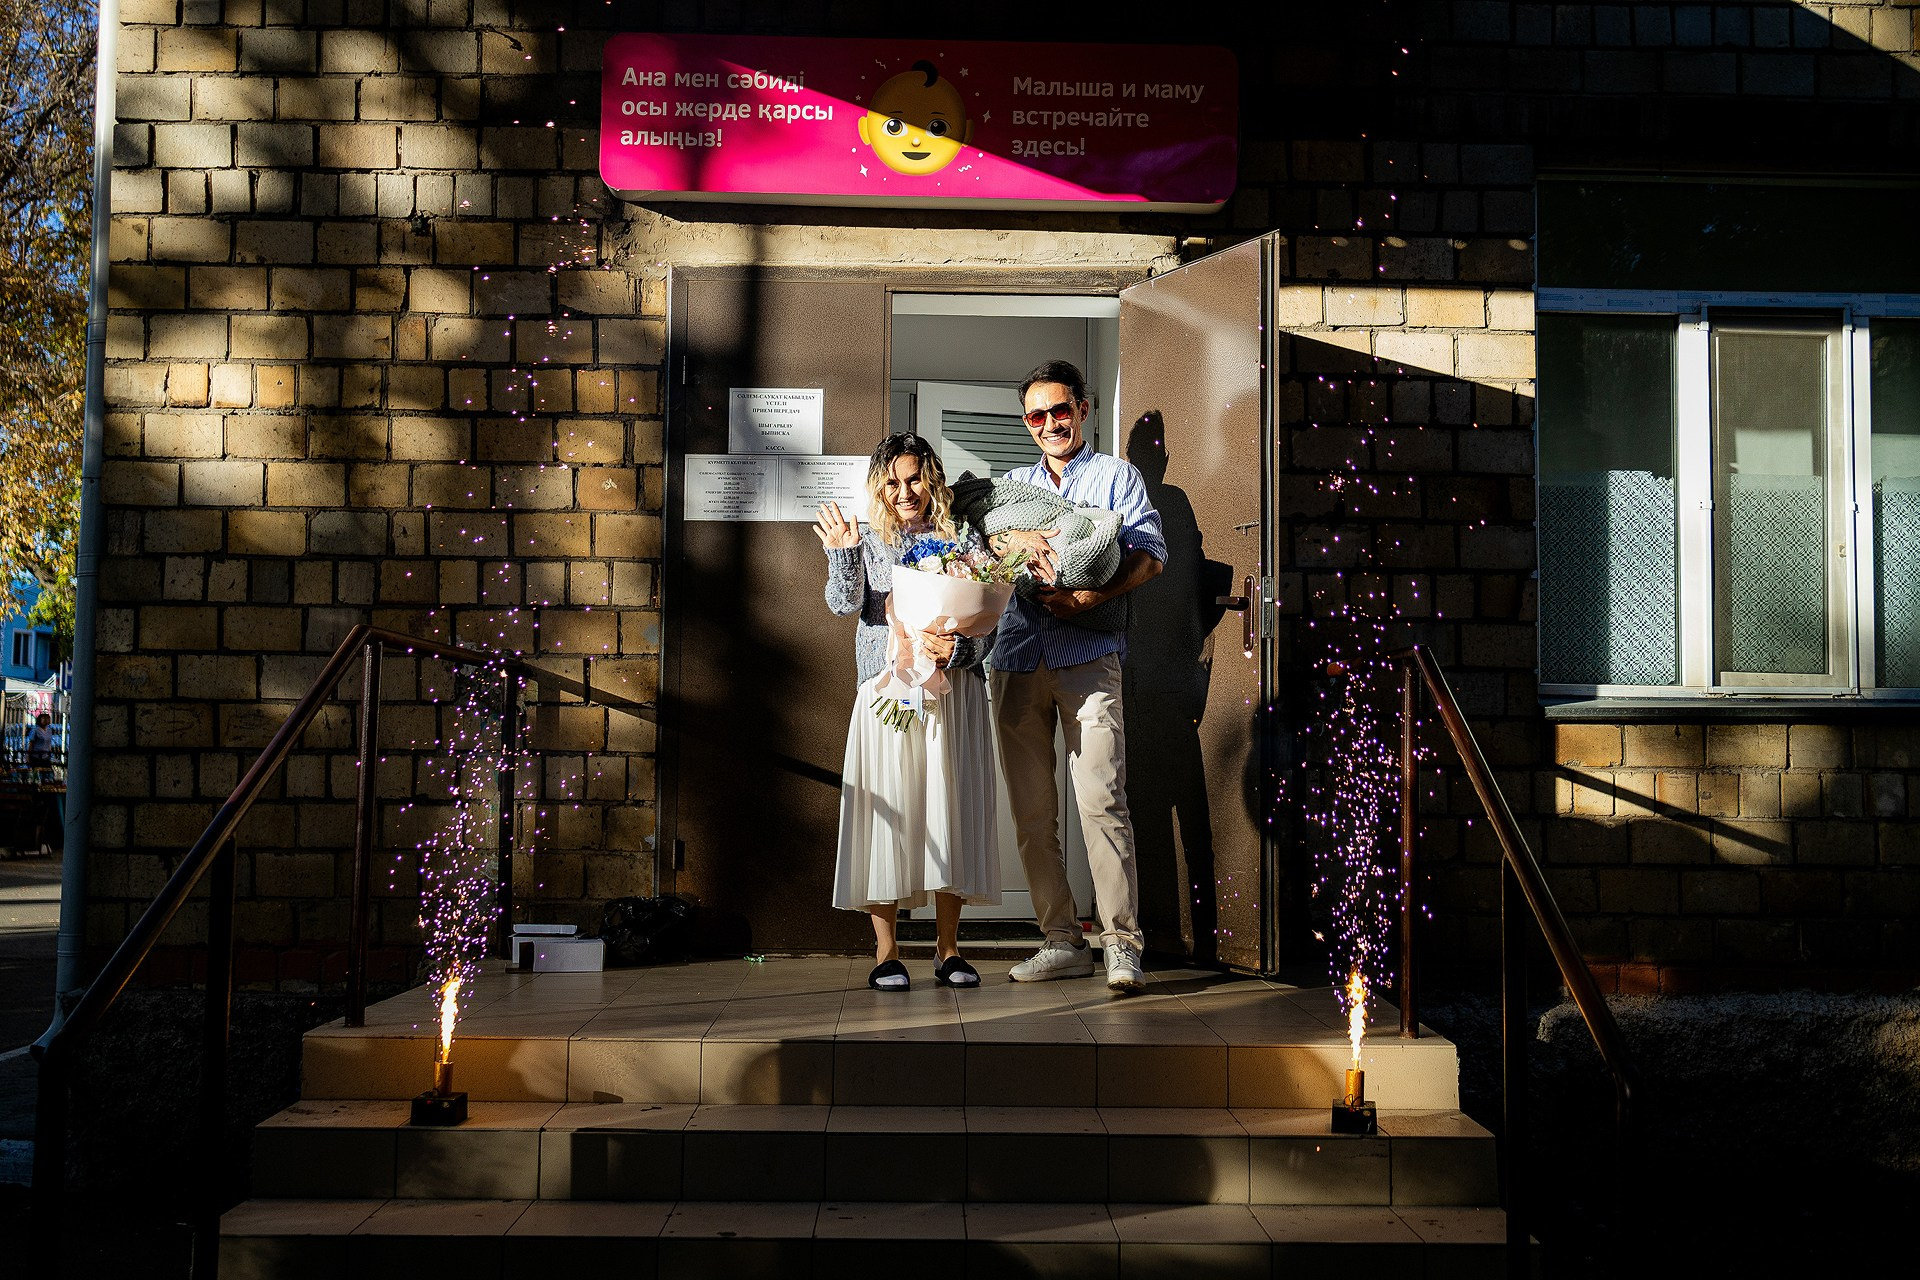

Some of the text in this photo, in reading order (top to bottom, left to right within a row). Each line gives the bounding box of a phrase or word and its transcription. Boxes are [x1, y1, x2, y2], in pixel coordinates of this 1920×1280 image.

[621, 67, 805, 94] Ана мен сәбиді
[1012, 76, 1205, 104] Малыша и маму
[621, 99, 833, 127] осы жерде қарсы
[1012, 106, 1149, 132] встречайте
[620, 127, 723, 151] алыңыз!
[1012, 136, 1086, 159] здесь!
